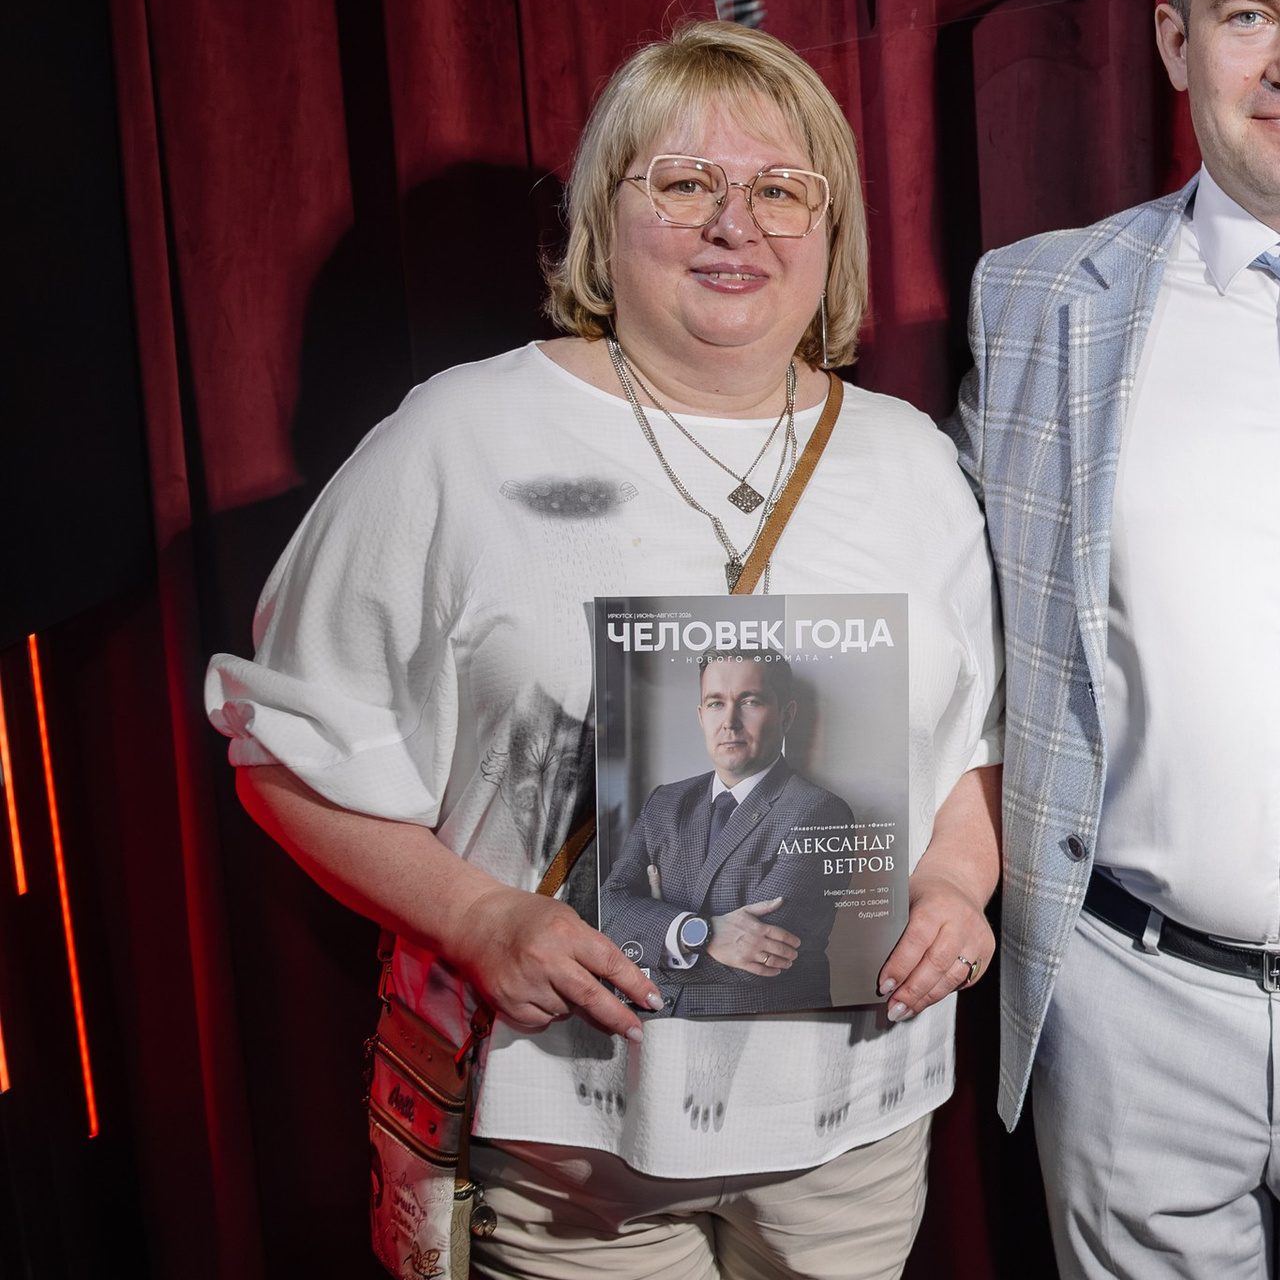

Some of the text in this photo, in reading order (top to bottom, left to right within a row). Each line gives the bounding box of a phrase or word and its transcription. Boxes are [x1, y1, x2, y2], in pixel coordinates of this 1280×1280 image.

[607, 618, 894, 653] ЧЕЛОВЕК ГОДА
[686, 654, 819, 664] НОВОГО ФОРМАТА
[777, 834, 895, 855] АЛЕКСАНДР
[823, 855, 895, 875] ВЕТРОВ
[823, 888, 866, 896] Инвестиции
[623, 948, 639, 957] 18+
